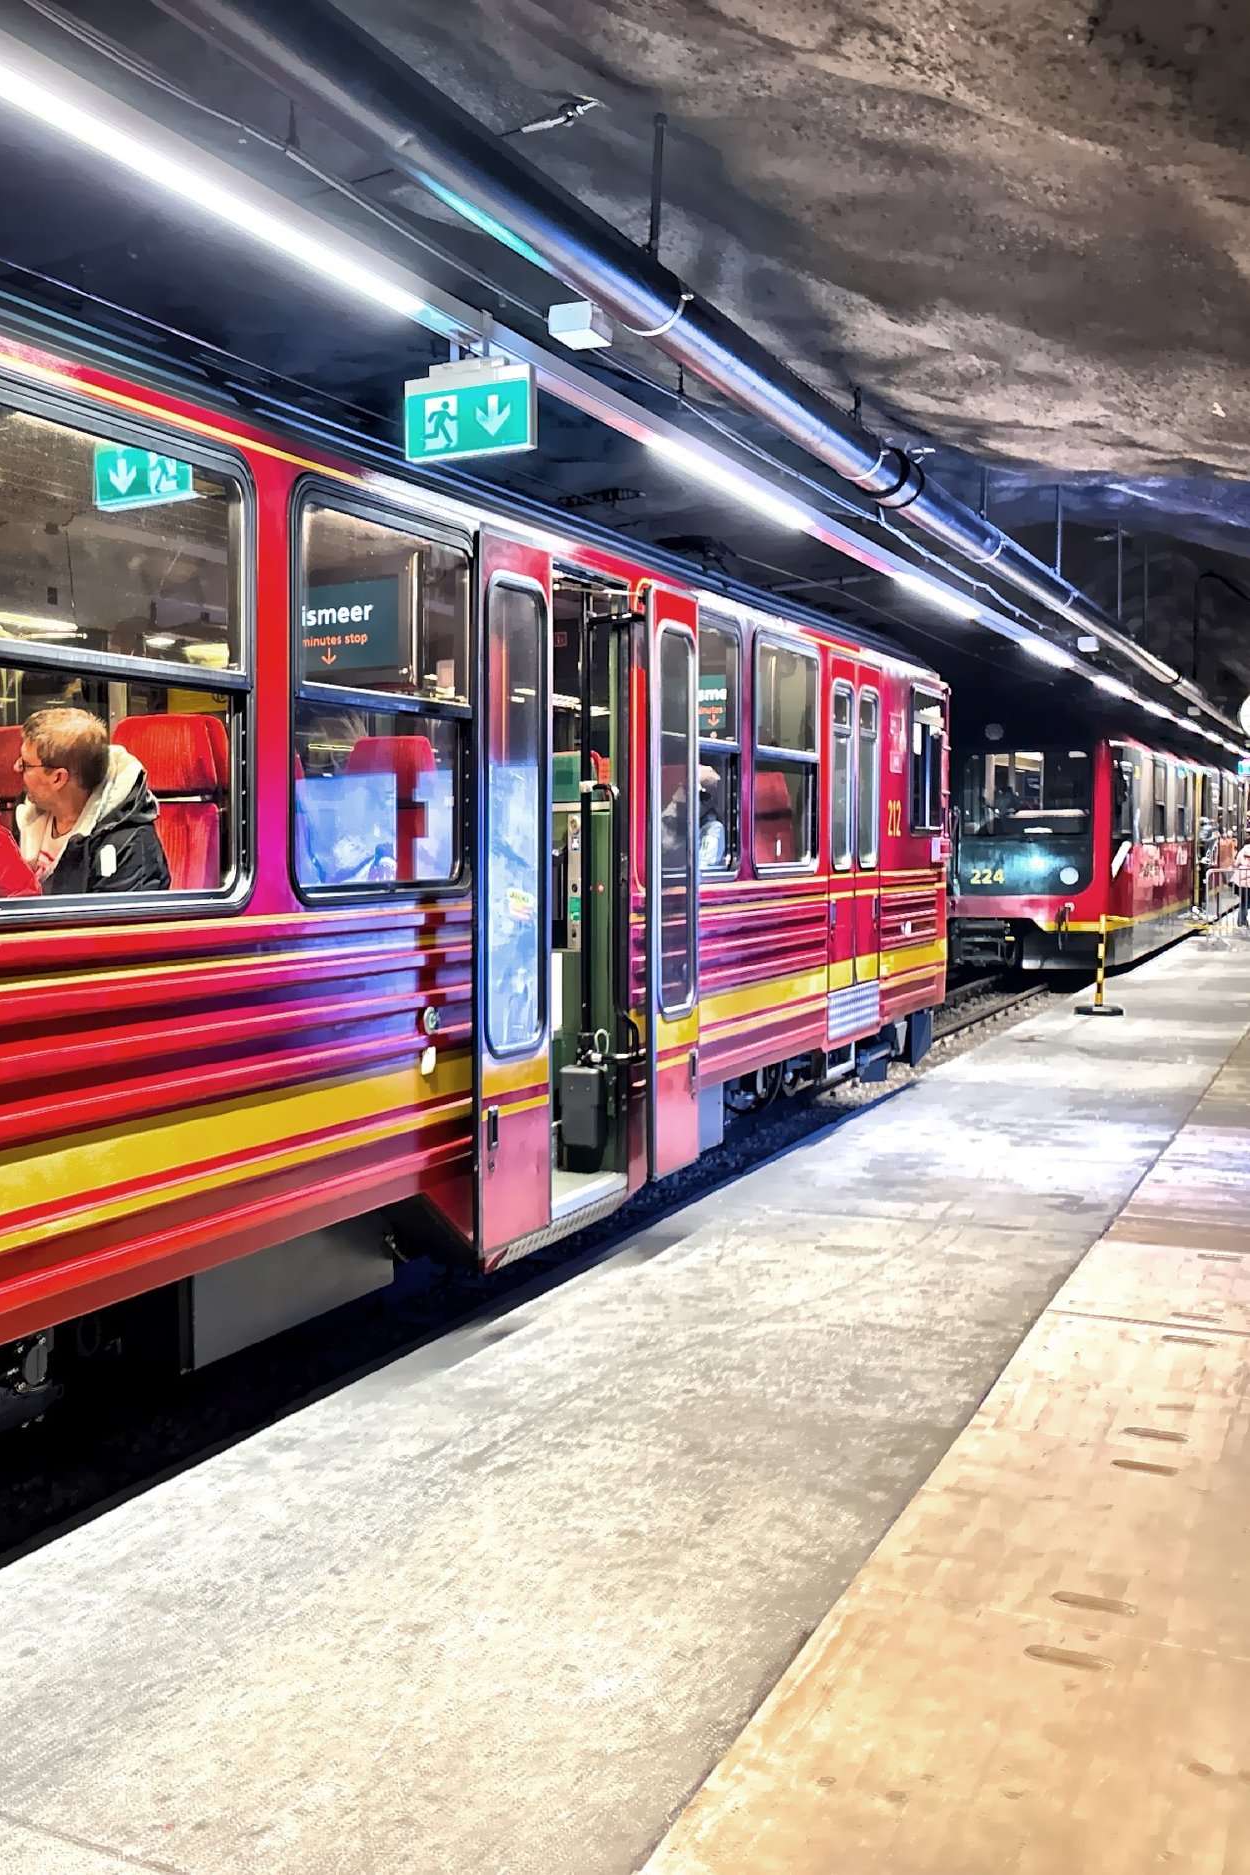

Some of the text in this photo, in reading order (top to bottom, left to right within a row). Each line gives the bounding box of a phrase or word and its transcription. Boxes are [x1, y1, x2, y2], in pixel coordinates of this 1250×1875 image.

[302, 633, 368, 647] minutes stop
[887, 799, 902, 837] 212
[970, 868, 1005, 885] 224
